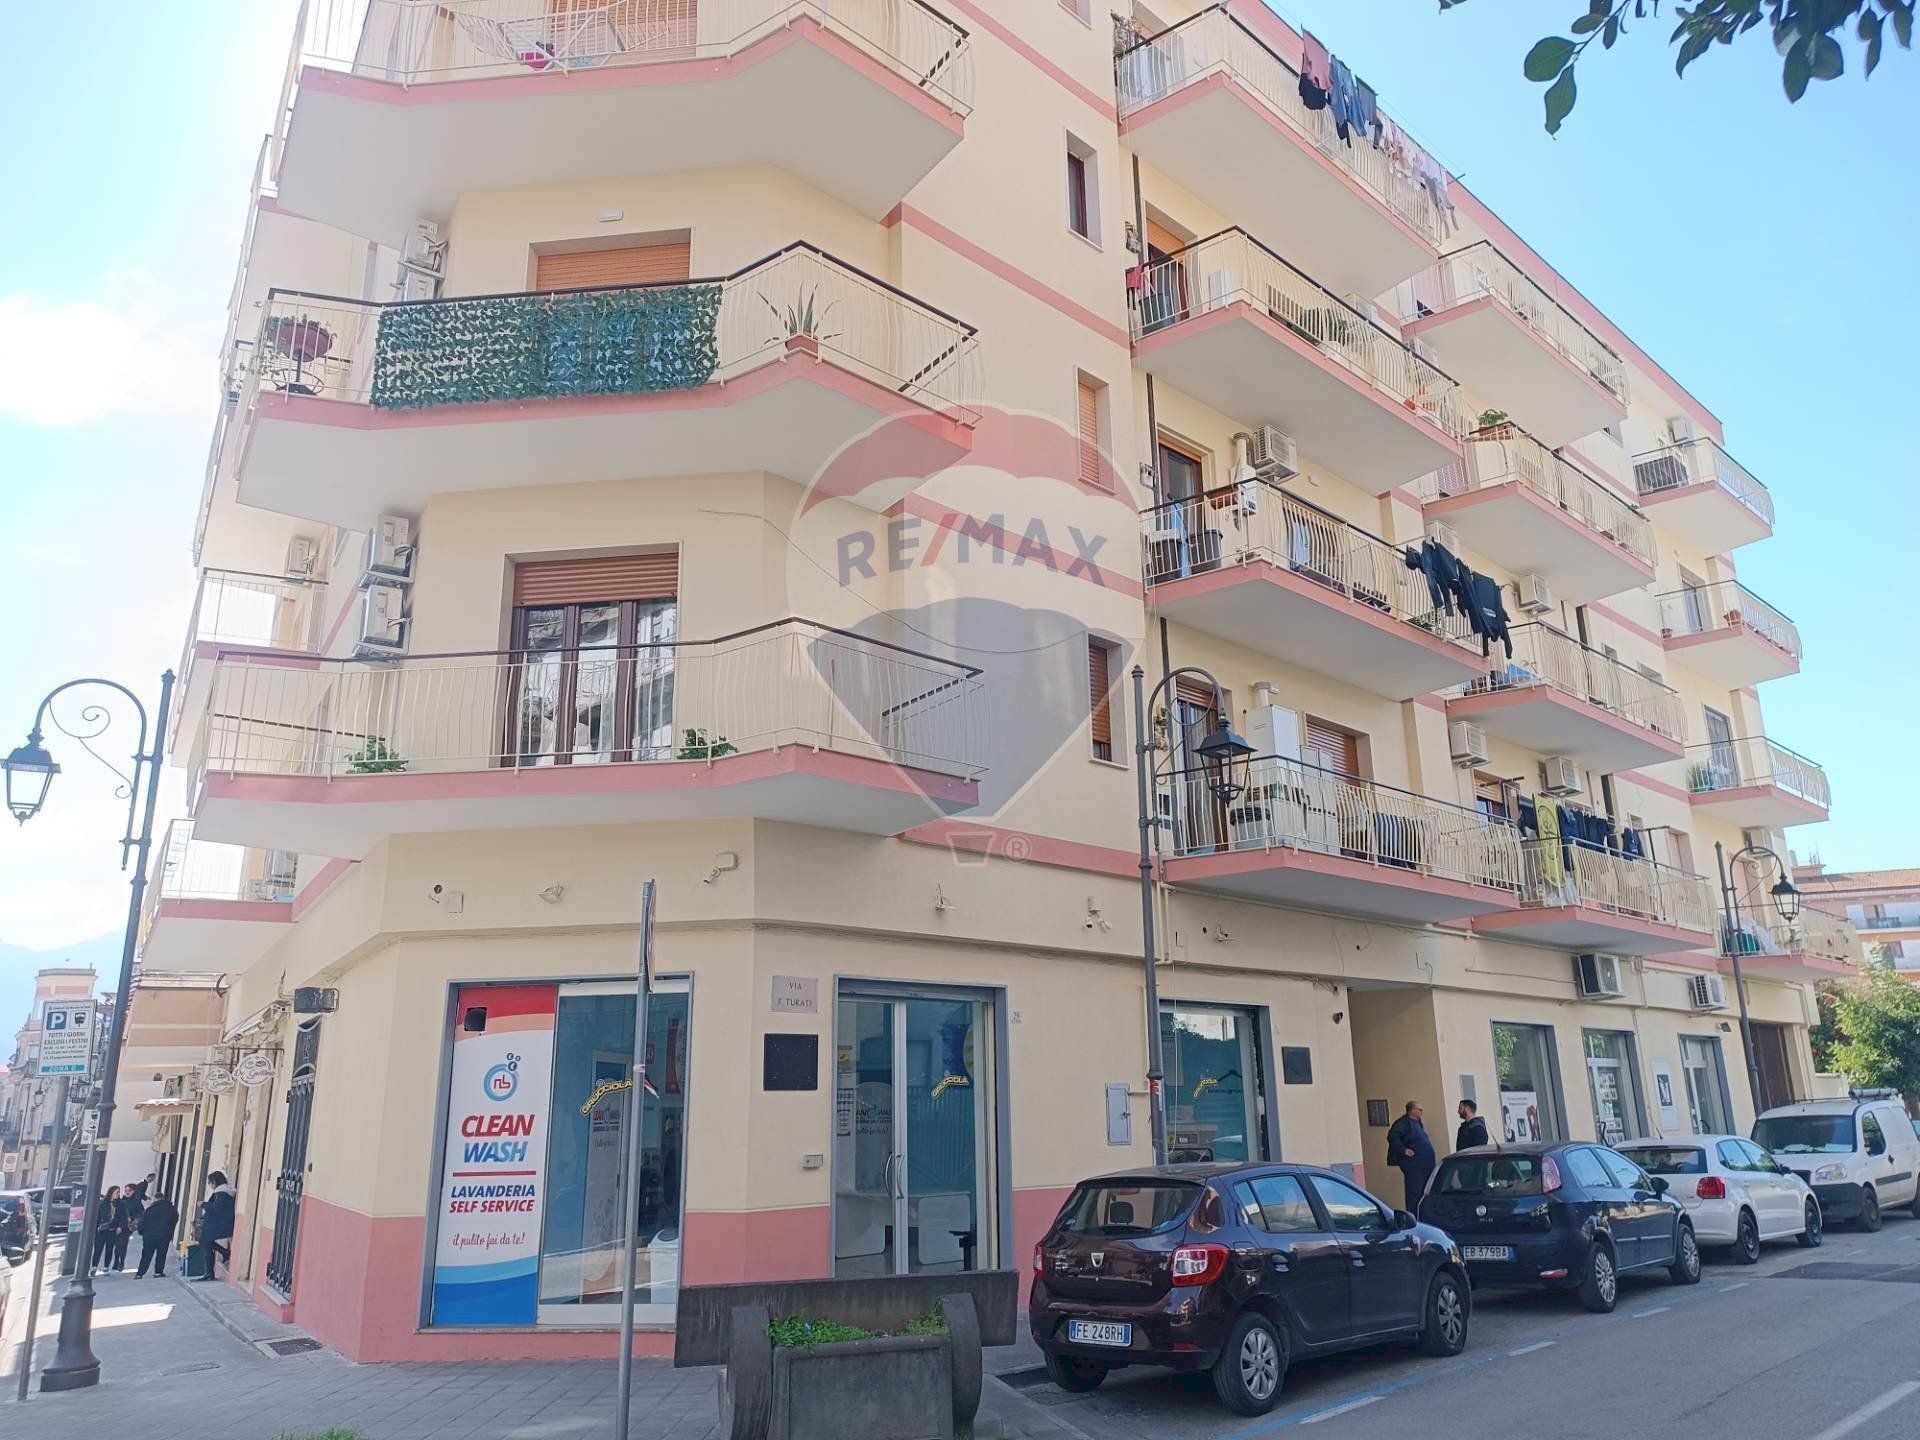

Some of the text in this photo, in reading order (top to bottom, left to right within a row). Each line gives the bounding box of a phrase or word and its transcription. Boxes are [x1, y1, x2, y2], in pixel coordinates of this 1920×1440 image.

[789, 981, 802, 990] VIA
[786, 998, 812, 1008] TURATI
[50, 1012, 65, 1029] P
[461, 1113, 535, 1137] CLEAN
[463, 1141, 529, 1163] WASH
[450, 1184, 536, 1198] LAVANDERIA
[449, 1199, 535, 1213] SELF SERVICE
[452, 1231, 526, 1250] il pulito fai da te!
[1076, 1323, 1089, 1338] FE
